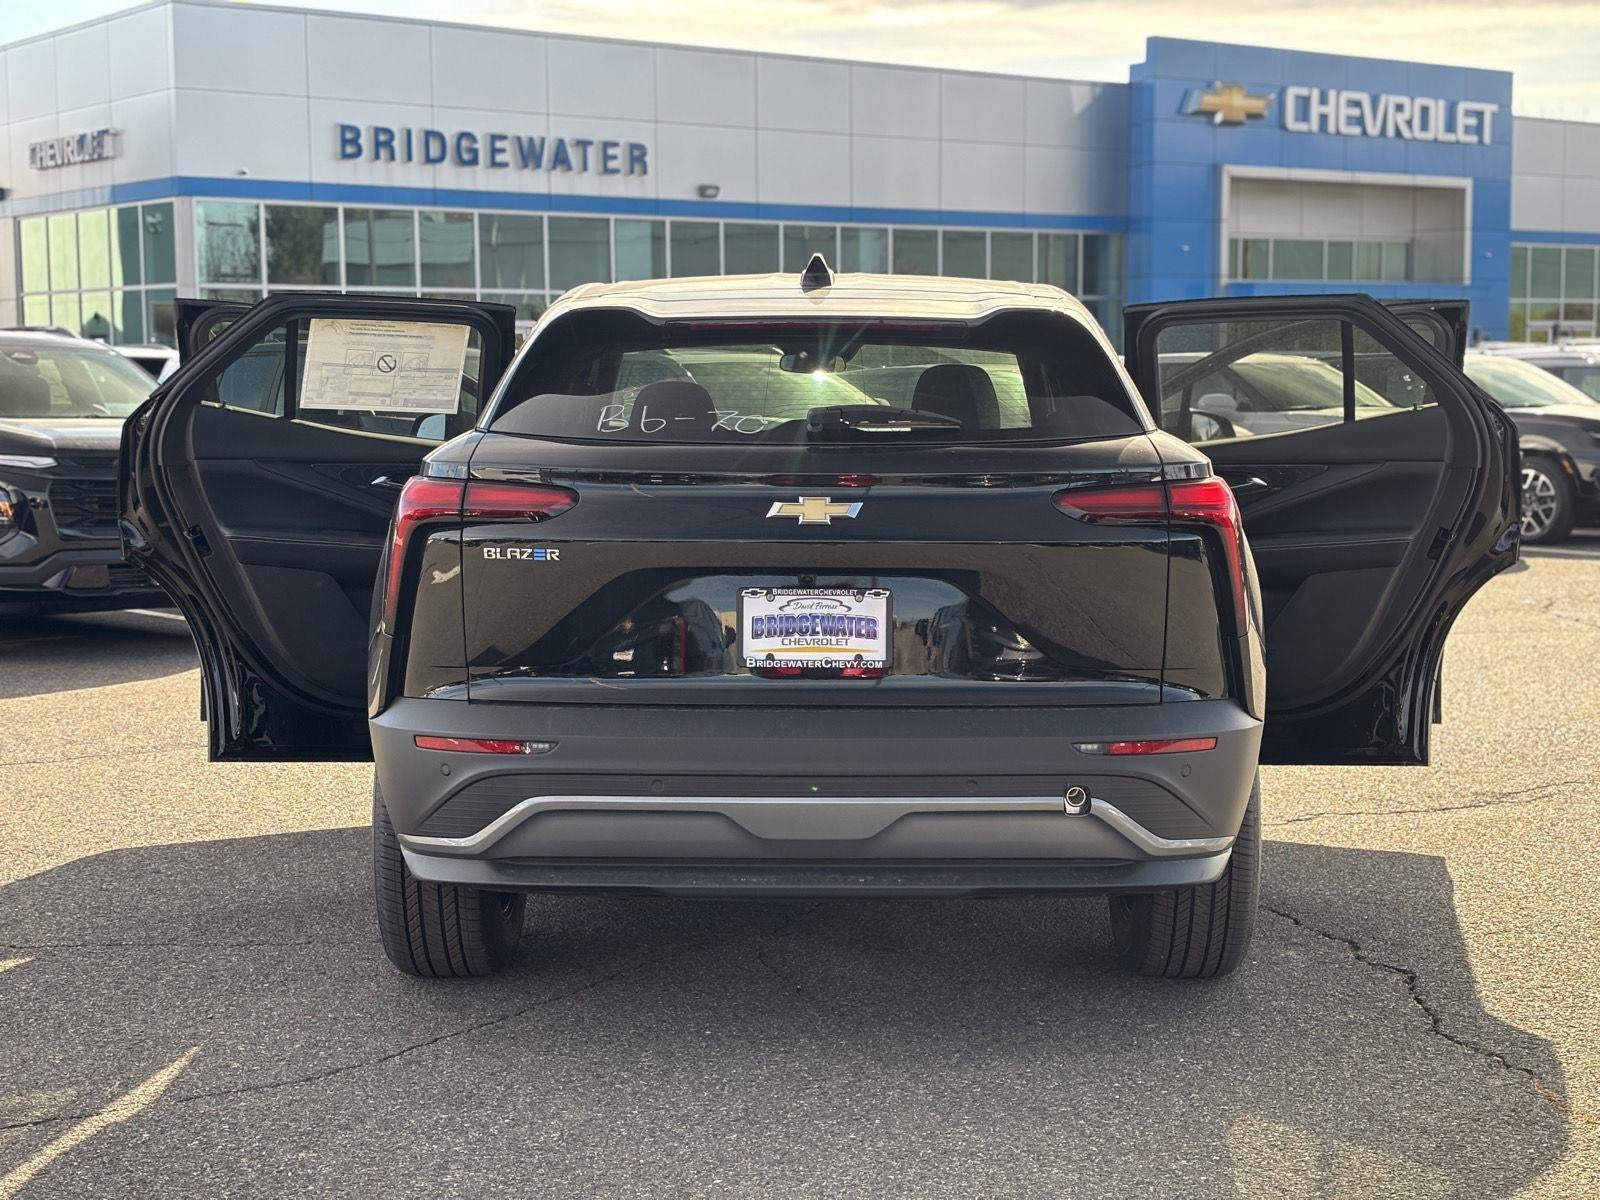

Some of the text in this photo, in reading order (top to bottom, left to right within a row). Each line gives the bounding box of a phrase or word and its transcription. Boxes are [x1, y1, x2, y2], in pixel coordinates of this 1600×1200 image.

[1284, 86, 1498, 145] CHEVROLET
[338, 122, 648, 176] BRIDGEWATER
[483, 547, 560, 561] BLAZER
[751, 612, 879, 640] BRIDGEWATER
[781, 637, 850, 646] CHEVROLET
